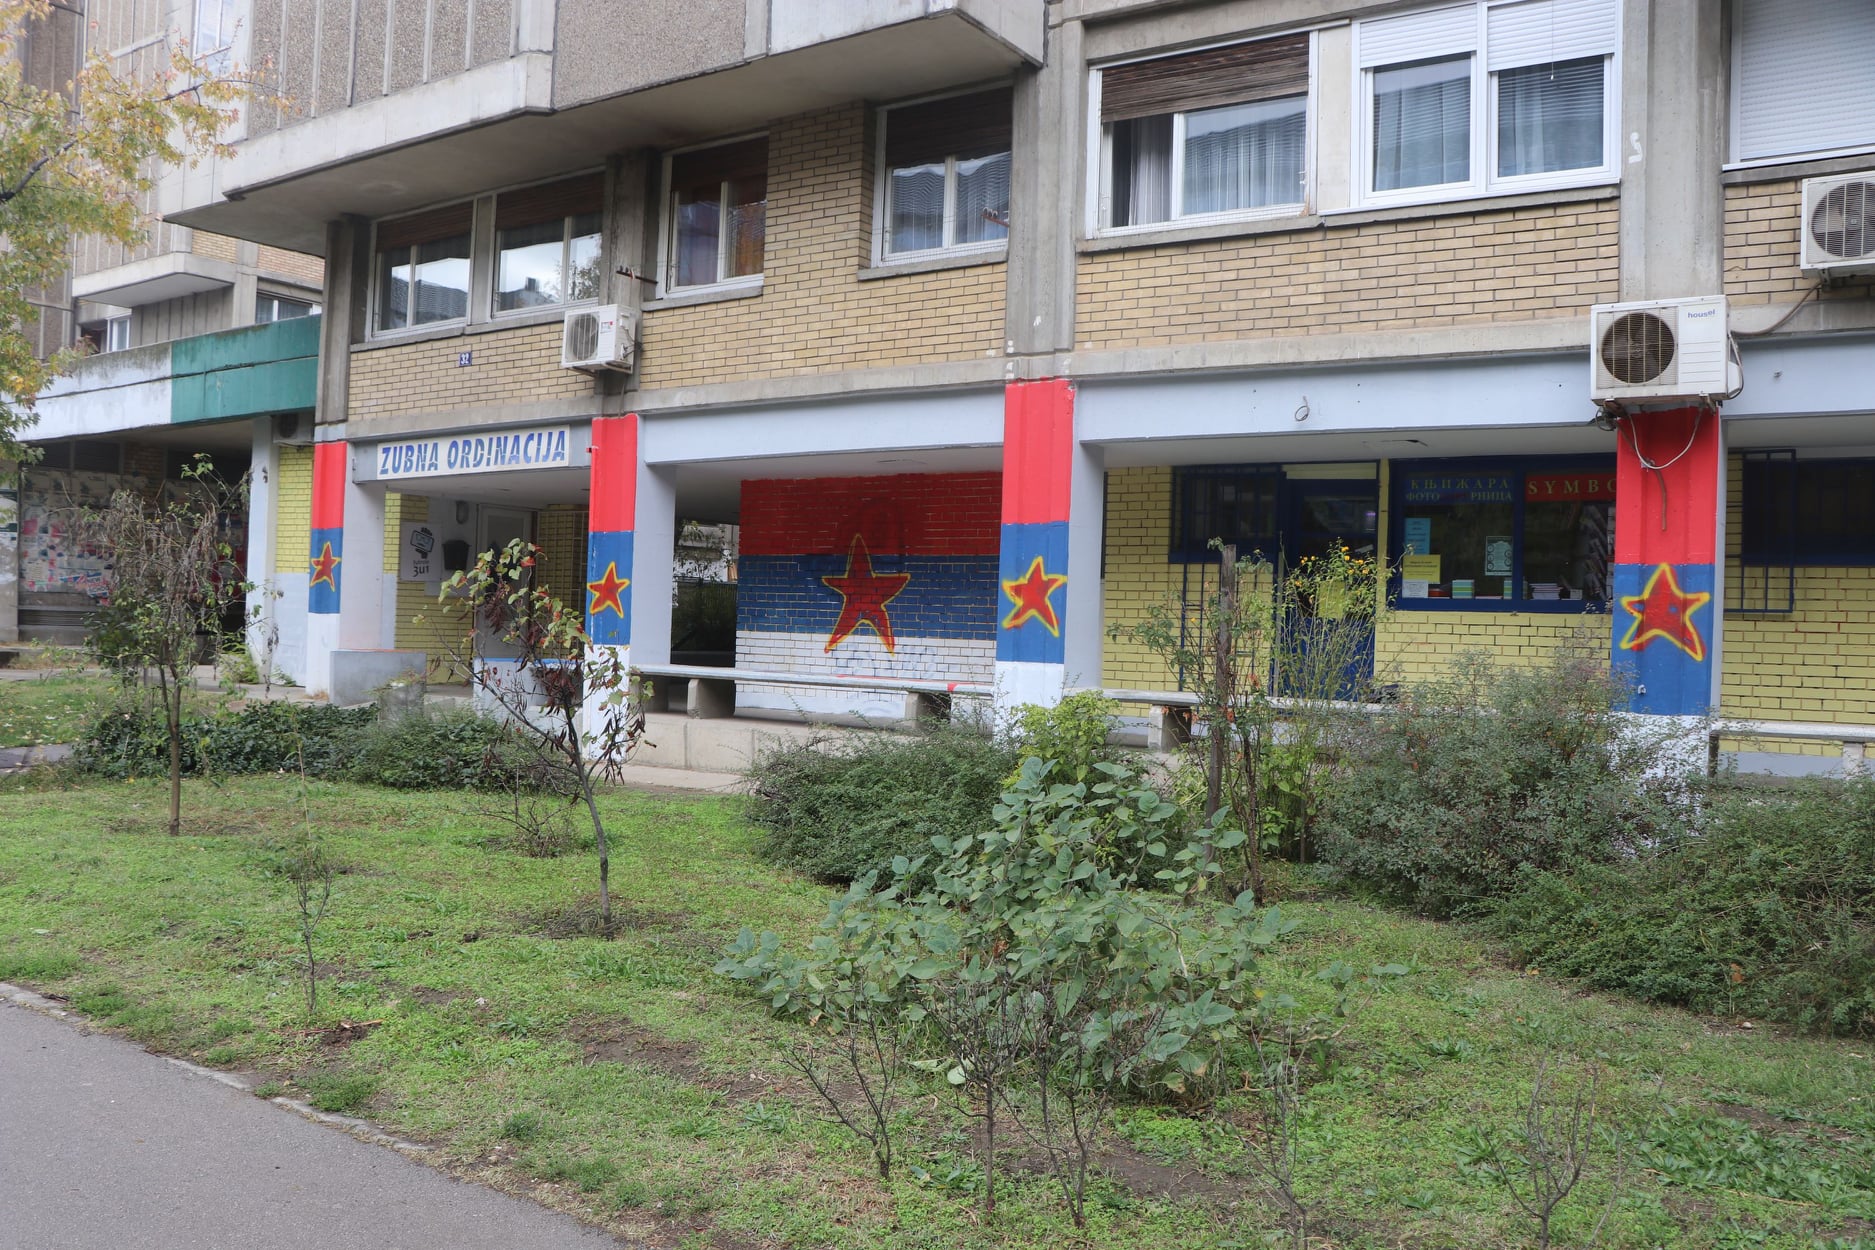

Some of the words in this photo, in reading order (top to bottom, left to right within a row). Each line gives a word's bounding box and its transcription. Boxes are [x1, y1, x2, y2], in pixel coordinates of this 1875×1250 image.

[460, 353, 470, 364] 32
[379, 442, 439, 475] ZUBNA
[447, 430, 566, 469] ORDINACIJA
[1411, 478, 1508, 489] КЊИЖАРА
